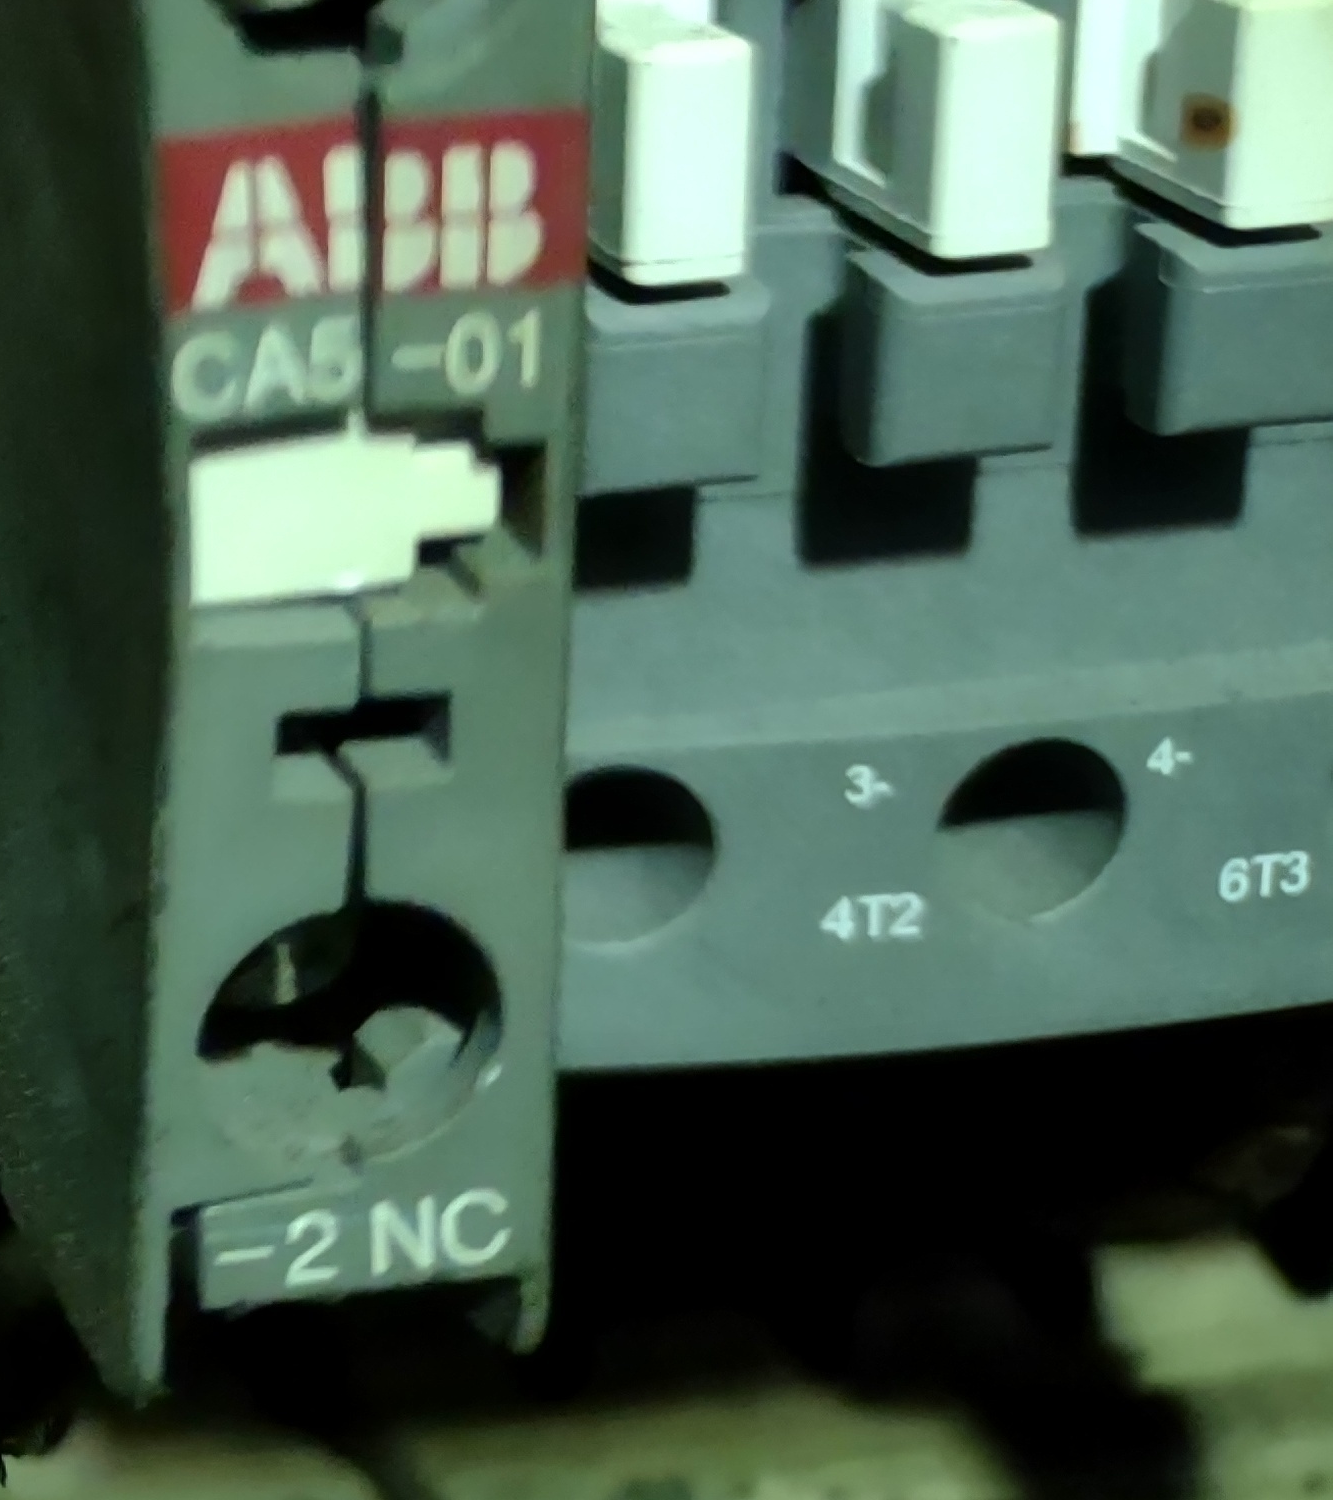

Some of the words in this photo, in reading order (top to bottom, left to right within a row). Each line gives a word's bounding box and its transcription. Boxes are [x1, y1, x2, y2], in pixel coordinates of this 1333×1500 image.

[189, 139, 545, 312] ABB
[1146, 736, 1194, 777] 4-
[844, 764, 894, 808] 3-
[1218, 850, 1311, 902] 6T3
[820, 891, 927, 942] 4T2
[369, 1188, 513, 1276] NC
